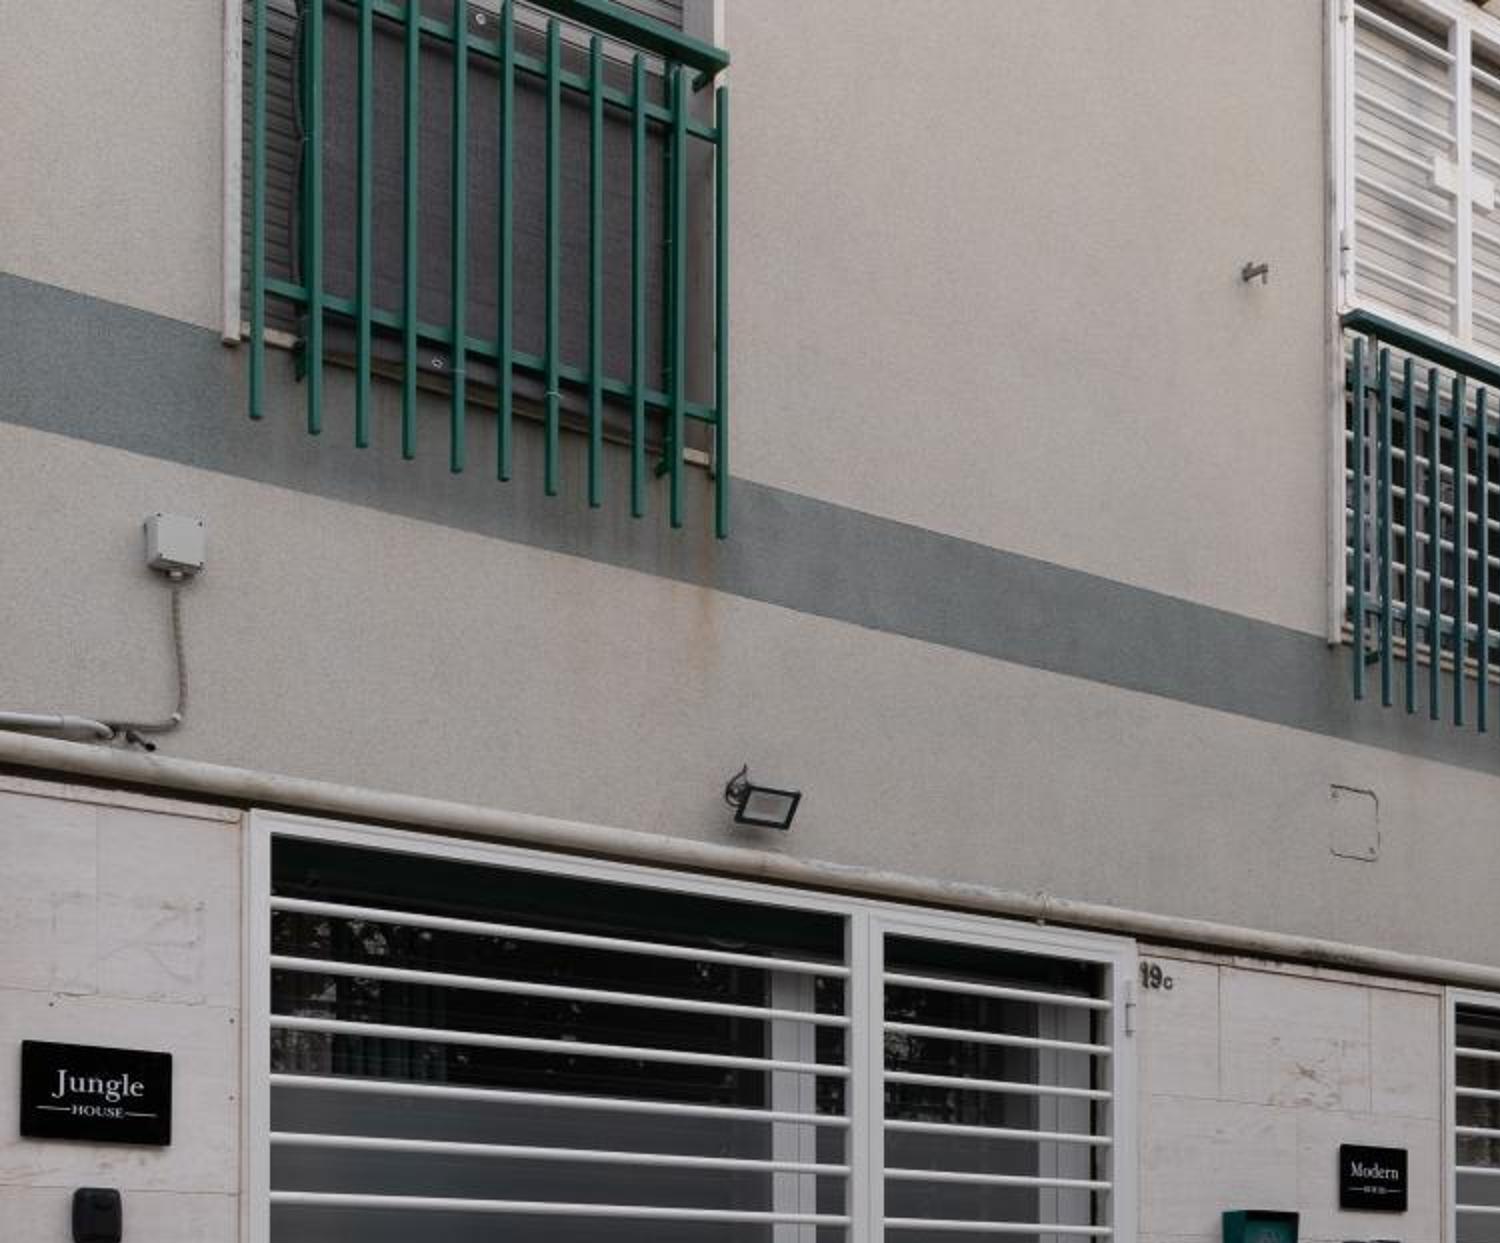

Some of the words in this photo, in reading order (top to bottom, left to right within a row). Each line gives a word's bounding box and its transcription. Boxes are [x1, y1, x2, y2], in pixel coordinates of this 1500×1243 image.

[51, 1069, 145, 1103] Jungle
[71, 1104, 125, 1119] HOUSE
[1350, 1160, 1400, 1180] Modern
